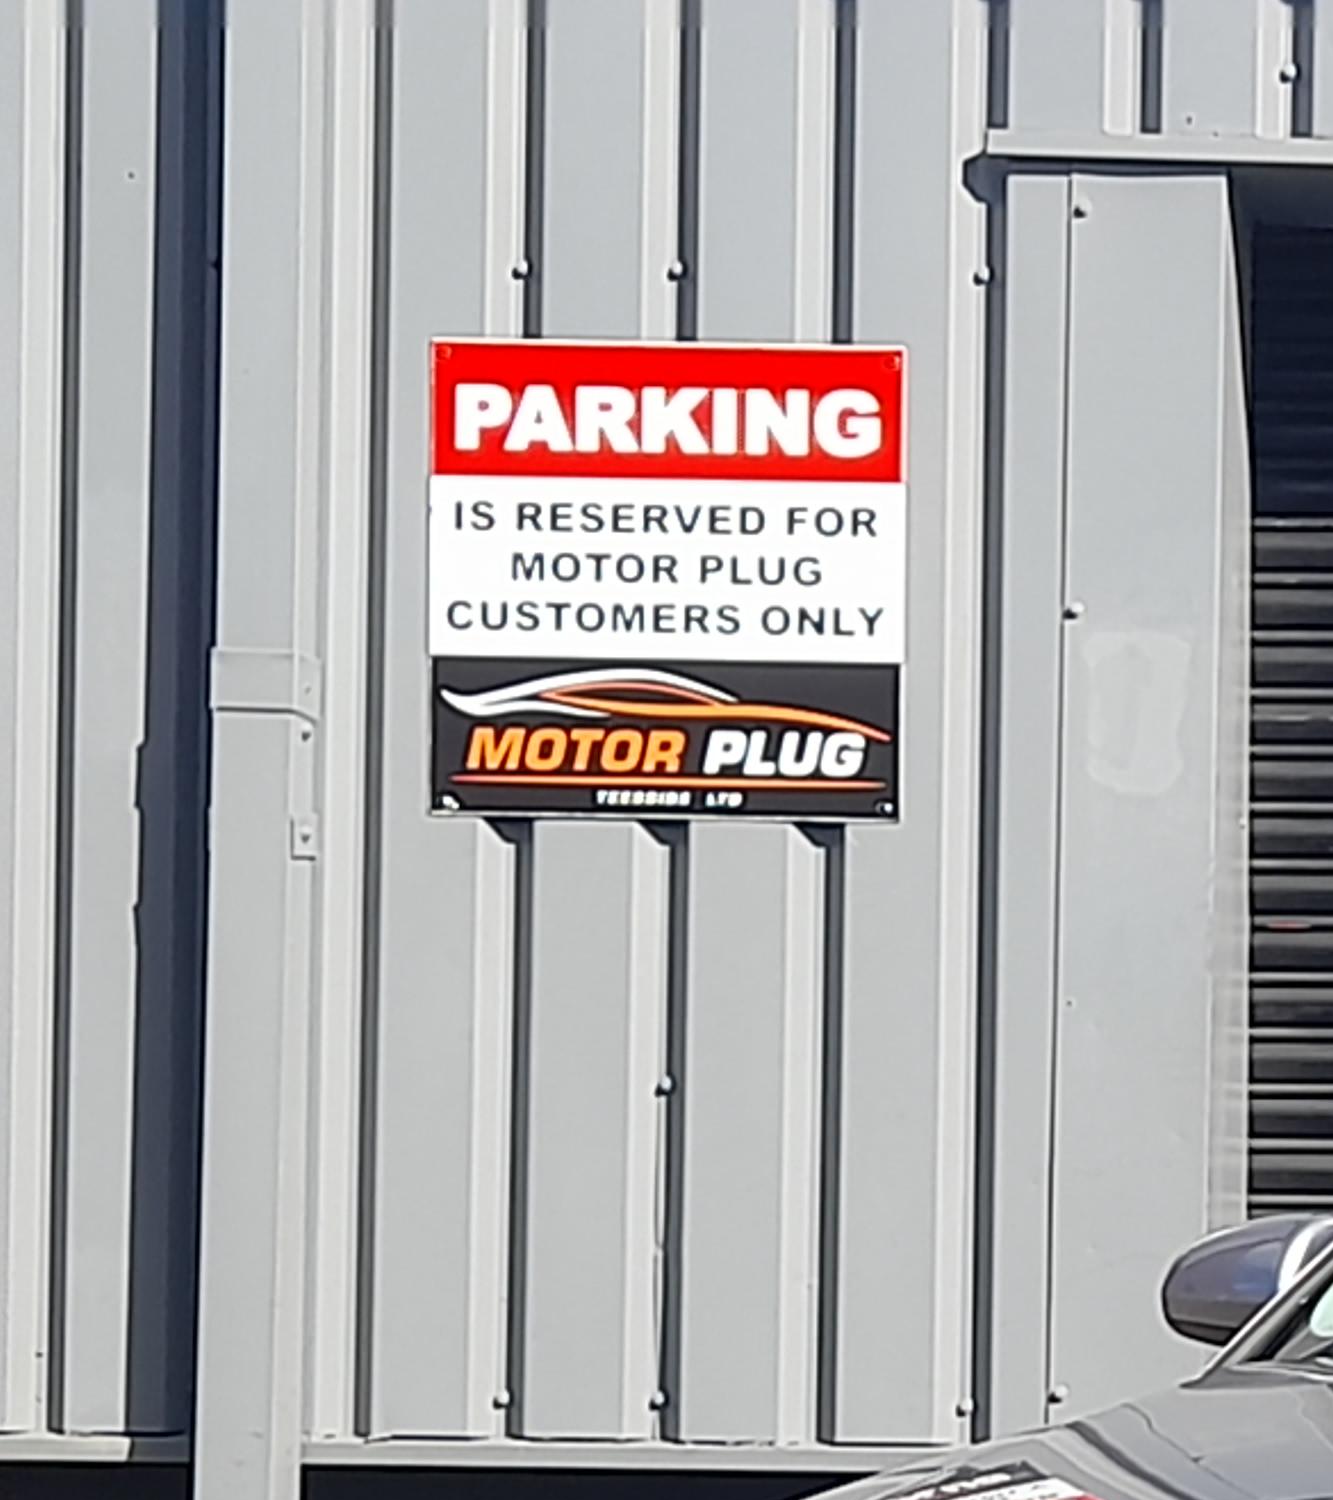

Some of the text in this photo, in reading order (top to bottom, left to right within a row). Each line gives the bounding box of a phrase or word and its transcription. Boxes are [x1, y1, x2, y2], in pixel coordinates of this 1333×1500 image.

[455, 384, 881, 458] PARKING
[455, 502, 876, 537] IS RESERVED FOR
[512, 553, 822, 586] MOTOR PLUG
[447, 601, 883, 636] CUSTOMERS ONLY
[466, 727, 867, 777] MOTOR PLUG
